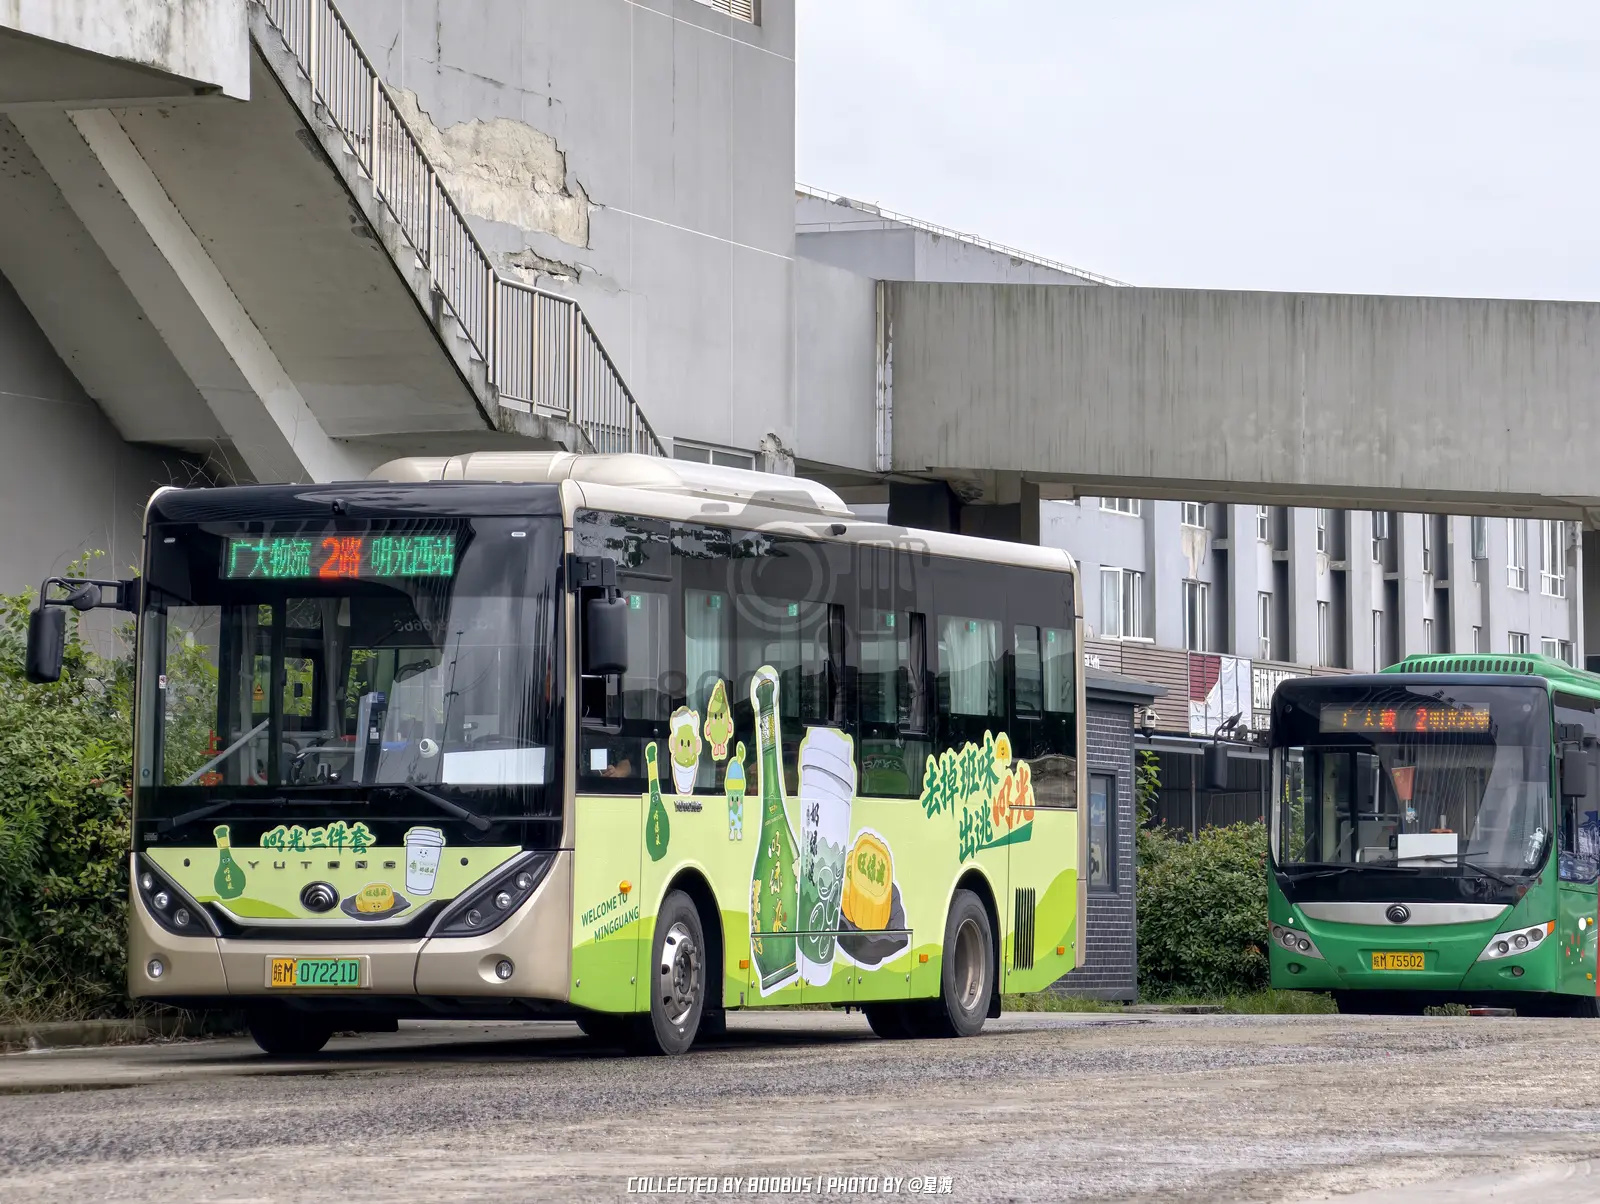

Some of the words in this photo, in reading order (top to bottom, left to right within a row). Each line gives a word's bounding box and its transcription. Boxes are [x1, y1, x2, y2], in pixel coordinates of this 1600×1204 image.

[227, 537, 311, 577] 广大物流
[319, 537, 362, 578] 2路
[371, 536, 455, 577] 明光西站
[921, 737, 1001, 820] 去掉班味
[263, 823, 372, 856] 明光三件套
[248, 860, 396, 869] YUTONG
[581, 895, 617, 927] WELCOME
[618, 891, 628, 906] TO
[594, 905, 639, 943] MINGGUANG
